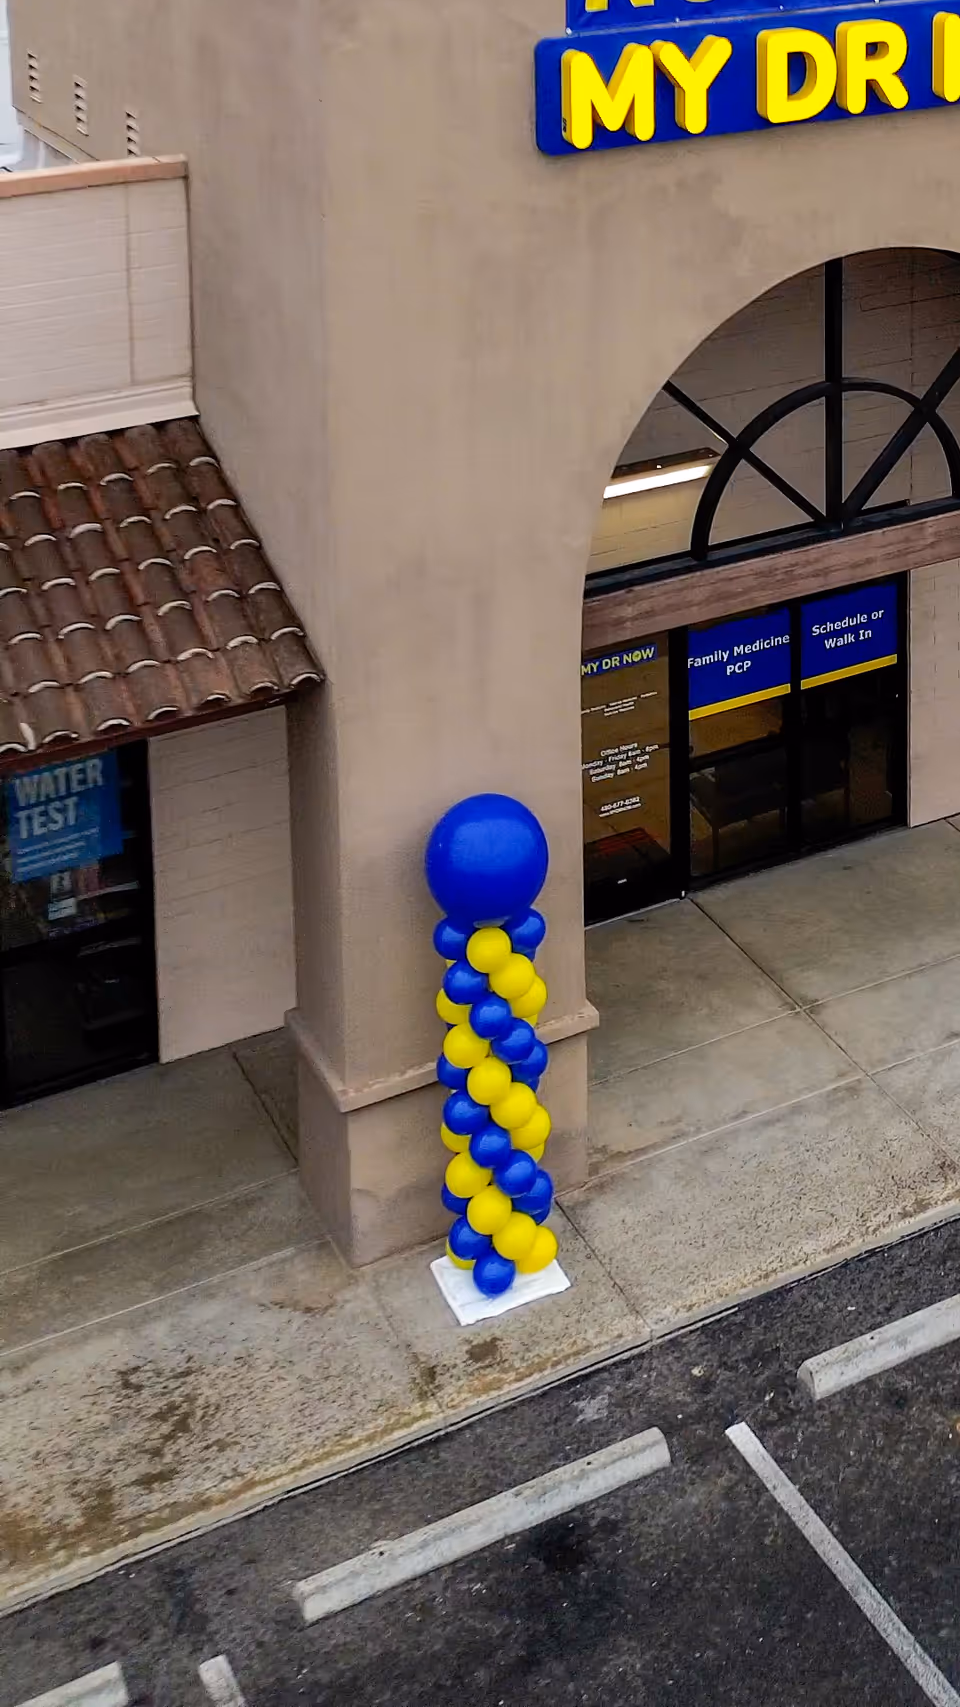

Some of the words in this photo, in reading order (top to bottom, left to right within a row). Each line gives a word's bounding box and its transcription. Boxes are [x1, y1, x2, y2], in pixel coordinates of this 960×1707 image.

[561, 34, 732, 150] MY
[756, 19, 909, 124] DR
[811, 611, 868, 636] Schedule
[871, 609, 885, 620] or
[687, 647, 730, 669] Family
[733, 633, 790, 657] Medicine
[824, 632, 856, 650] Walk
[859, 628, 872, 641] In
[581, 662, 600, 676] MY
[602, 656, 620, 670] DR
[623, 647, 655, 664] NOW
[726, 660, 752, 676] PCP
[14, 758, 104, 807] WATER
[14, 796, 80, 840] TEST
